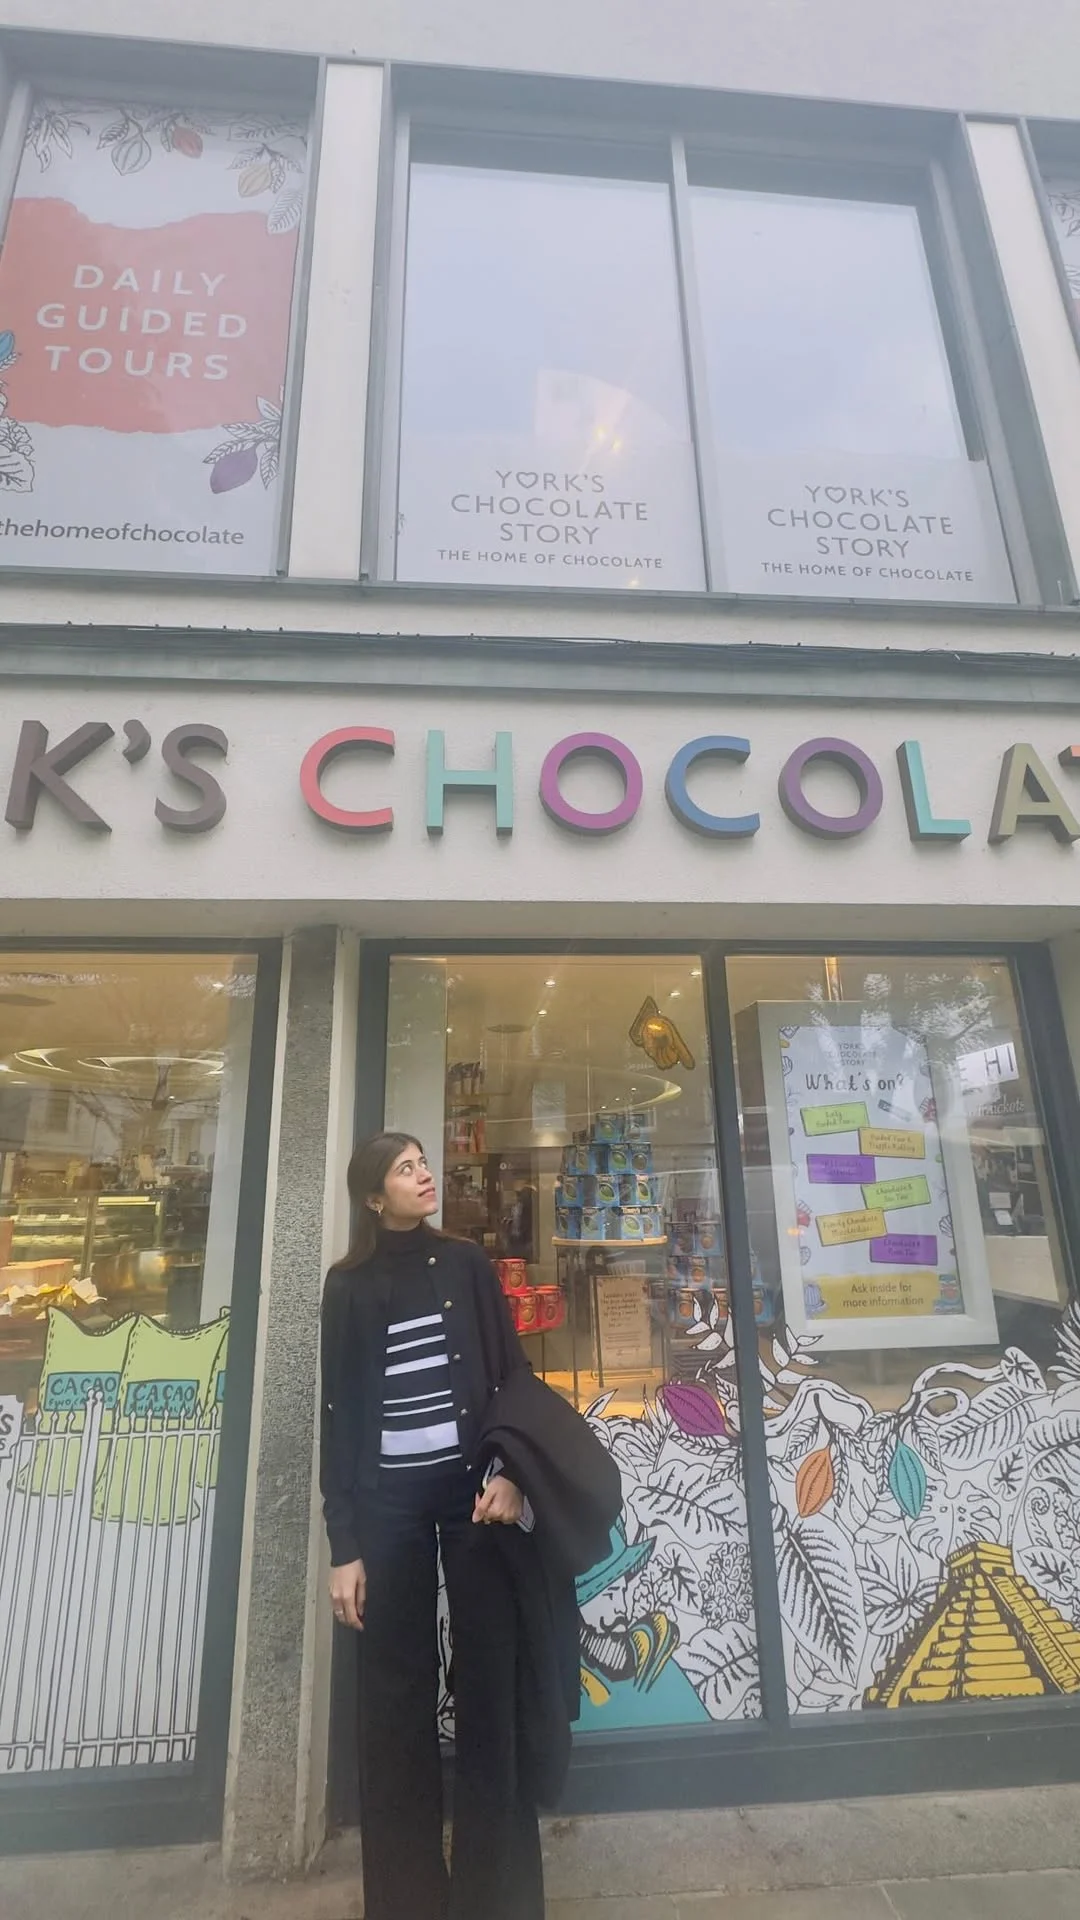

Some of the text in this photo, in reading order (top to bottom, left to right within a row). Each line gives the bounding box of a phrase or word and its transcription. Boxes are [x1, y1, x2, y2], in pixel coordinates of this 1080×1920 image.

[73, 264, 227, 298] DAILY
[36, 303, 248, 339] GUIDED
[44, 345, 230, 381] TOURS
[451, 494, 648, 521] CHOCOLATE
[500, 522, 599, 545] STORY
[767, 508, 954, 535] CHOCOLATE
[437, 549, 663, 569] THE HOME OF CHOCOLATE
[816, 536, 910, 558] STORY
[761, 562, 974, 582] THE HOME OF CHOCOLATE
[4, 718, 1080, 845] K'S CHOCOLA
[806, 1071, 871, 1092] What's
[851, 1280, 912, 1294] Ask inside for
[843, 1296, 924, 1308] more information
[50, 1376, 117, 1397] CACAO
[133, 1382, 195, 1403] CACAO
